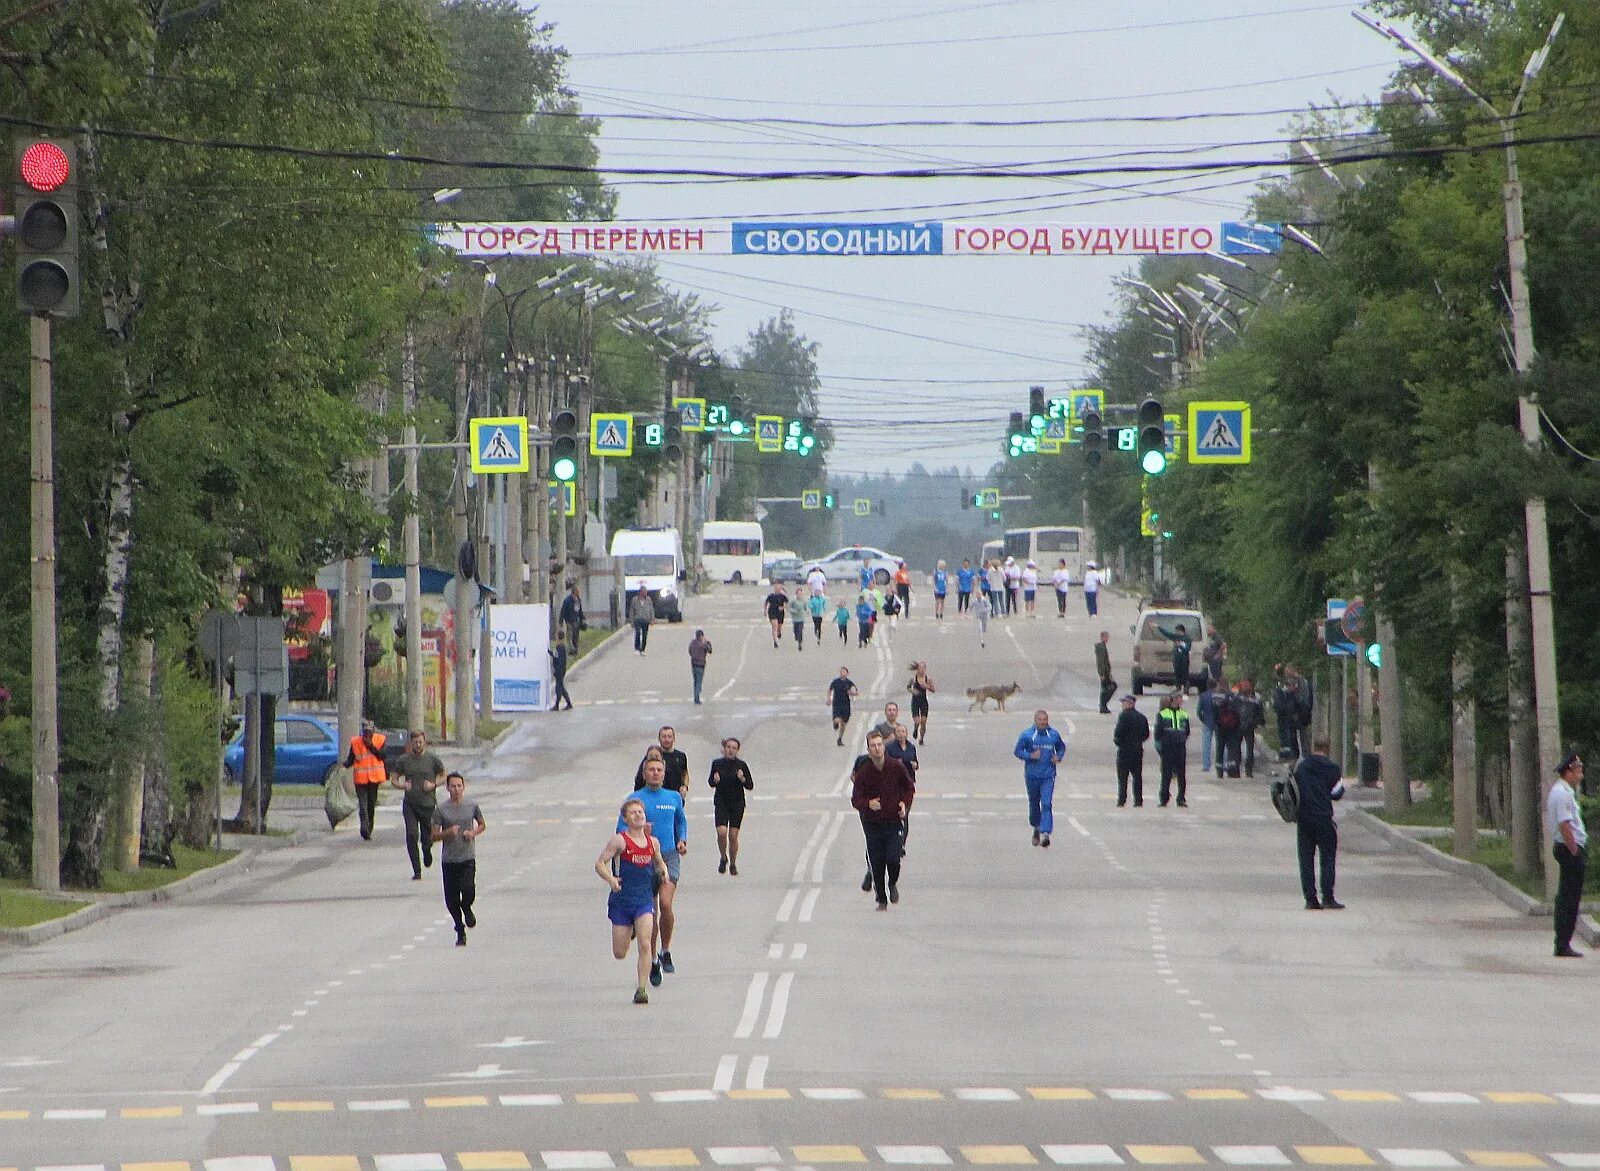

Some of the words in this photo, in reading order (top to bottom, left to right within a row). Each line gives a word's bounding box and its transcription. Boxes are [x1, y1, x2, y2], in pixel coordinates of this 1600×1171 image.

[464, 227, 561, 256] ГОРОД
[571, 227, 704, 251] ПЕРЕМЕН
[745, 223, 931, 255] СВОБОДНЫЙ
[954, 227, 1051, 256] ГОРОД
[1061, 227, 1213, 255] БУДУЩЕГО
[708, 406, 727, 423] 27
[1049, 398, 1070, 418] 27
[645, 424, 661, 446] 19
[1118, 428, 1135, 451] 19
